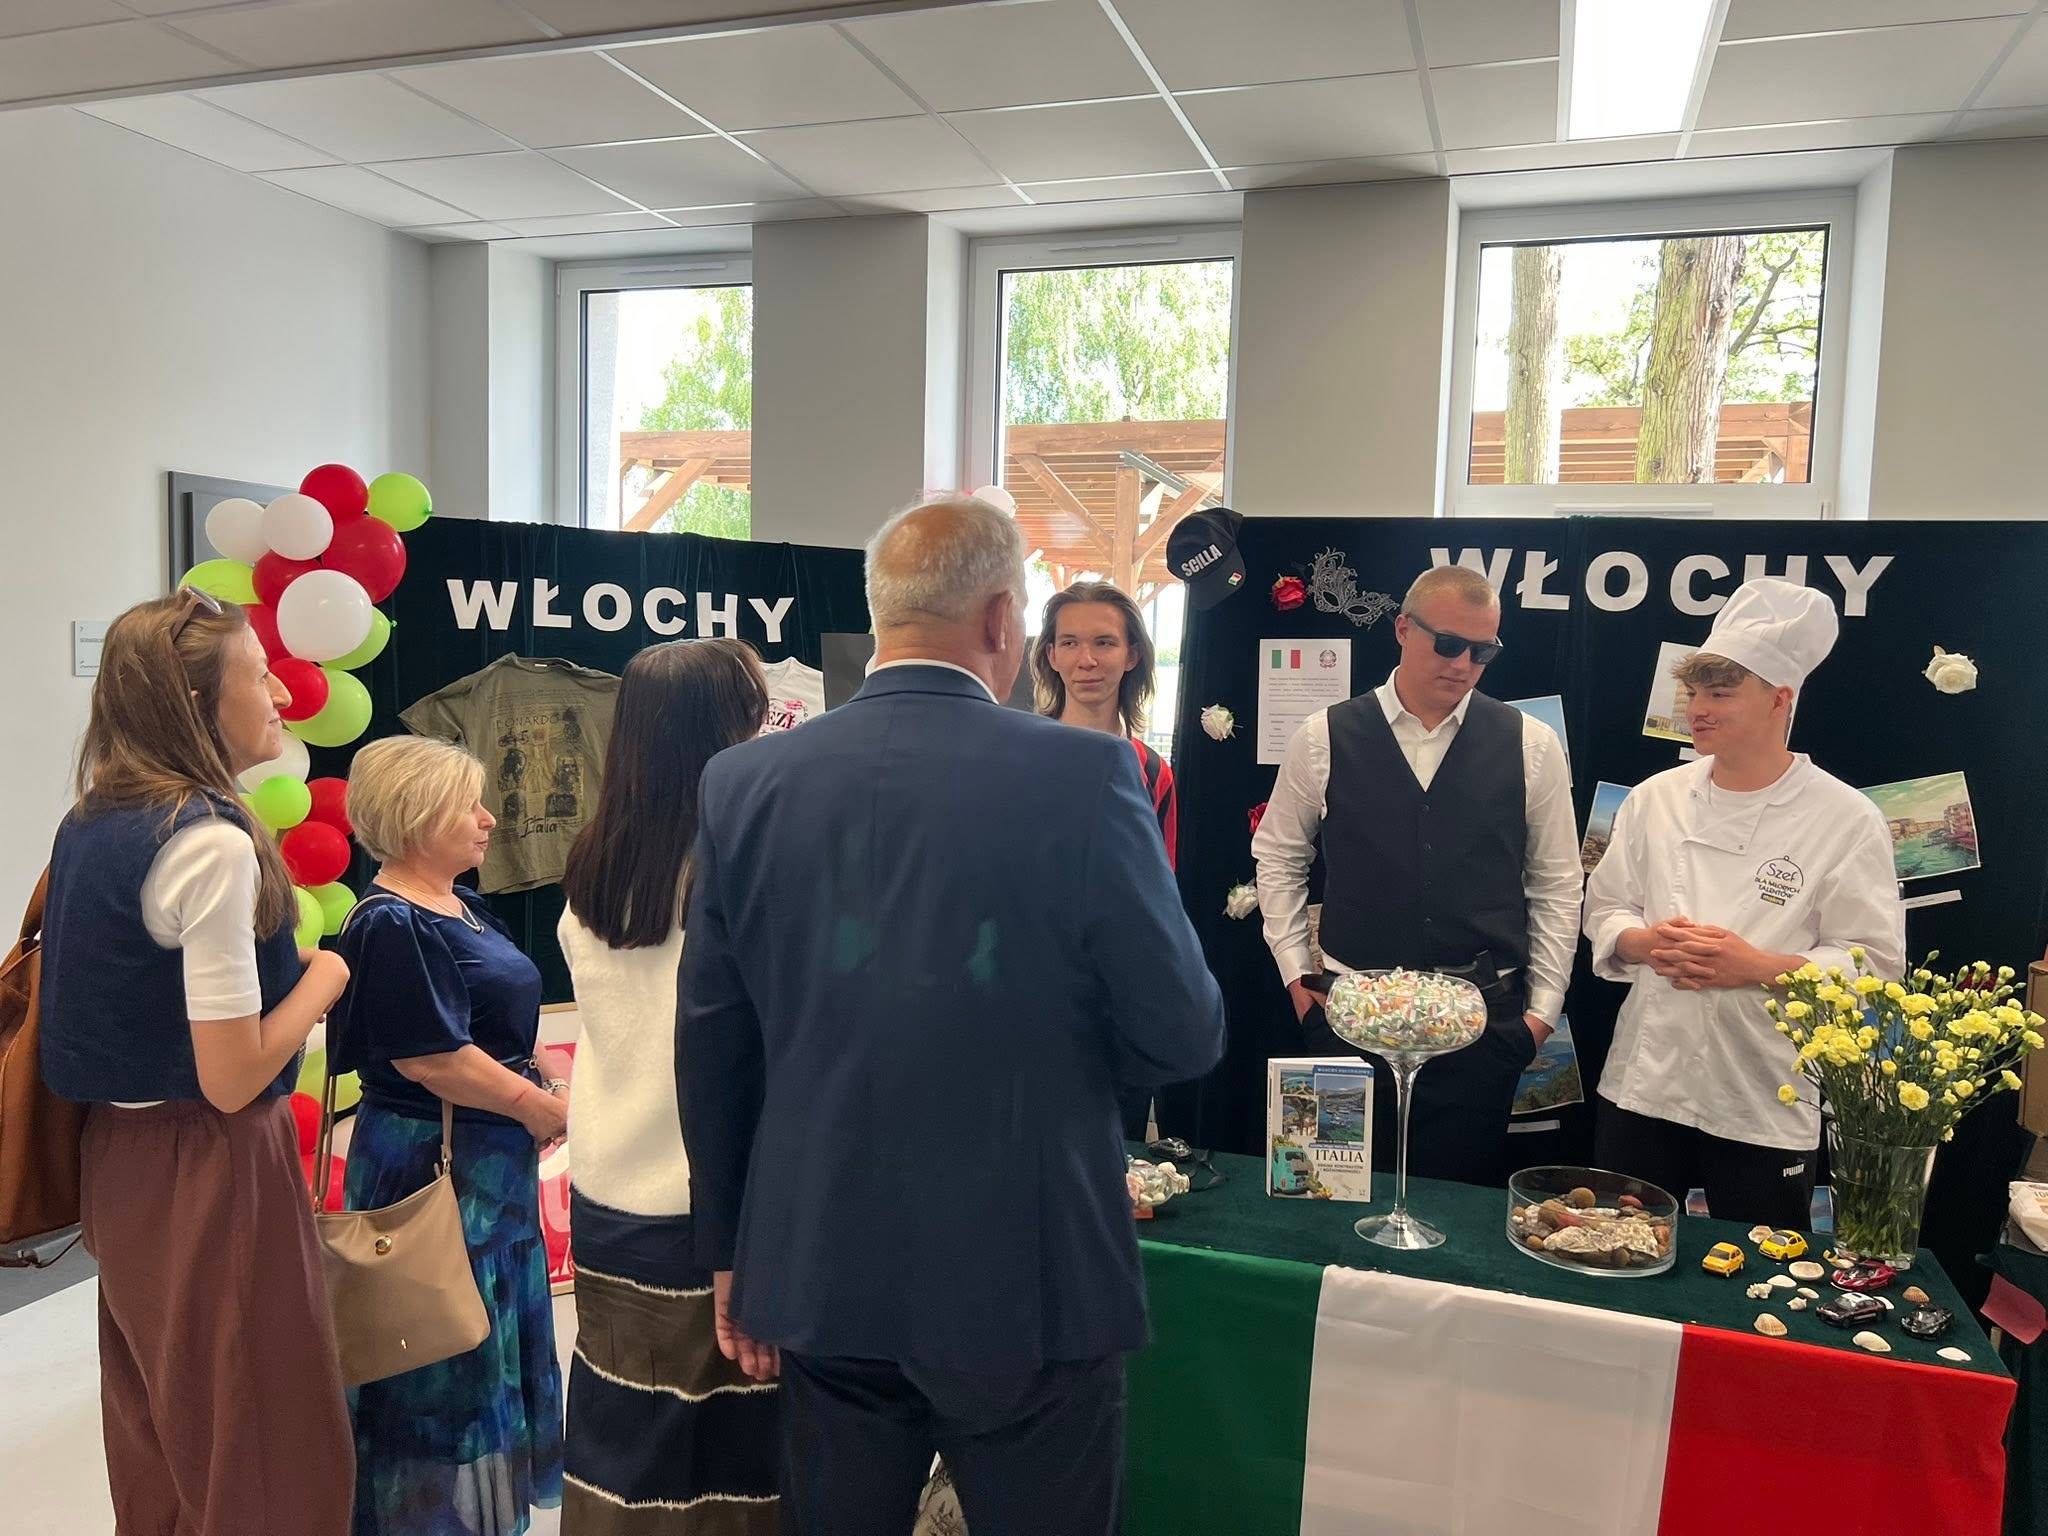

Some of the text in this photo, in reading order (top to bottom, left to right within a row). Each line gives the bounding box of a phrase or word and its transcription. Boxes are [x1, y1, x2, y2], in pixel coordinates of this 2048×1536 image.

[1181, 544, 1222, 577] SCILLA
[446, 578, 794, 643] WŁOCHY
[1766, 863, 1797, 882] Szef
[1316, 1149, 1364, 1163] ITALIA
